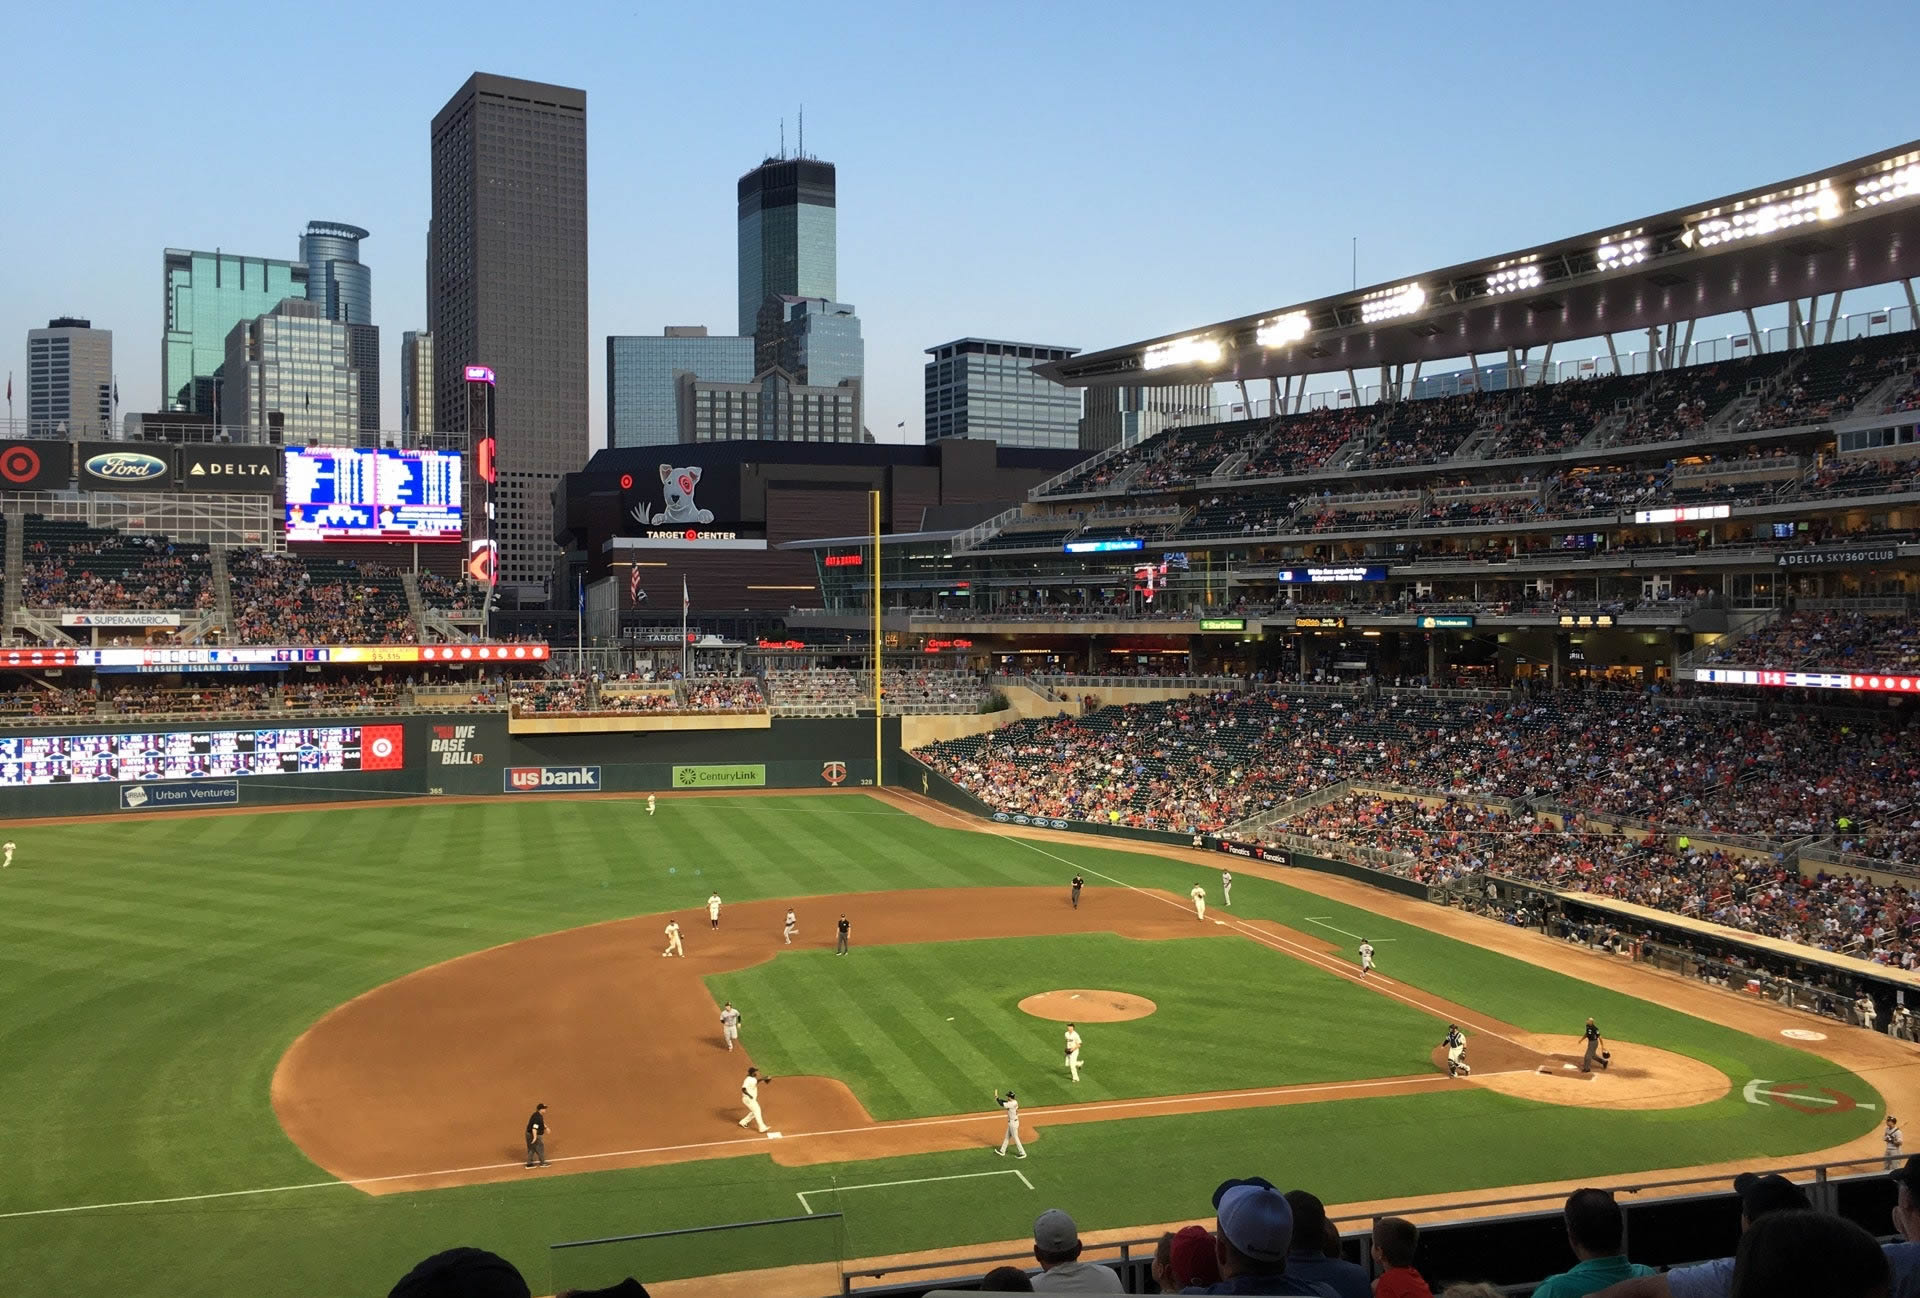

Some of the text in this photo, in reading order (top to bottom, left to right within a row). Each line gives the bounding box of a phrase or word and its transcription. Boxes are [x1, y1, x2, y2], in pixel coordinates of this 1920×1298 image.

[102, 456, 150, 476] Ford
[210, 463, 270, 475] DELTA
[647, 531, 736, 540] TARGET CENTER
[1789, 554, 1824, 564] DELTA
[1868, 551, 1894, 560] CLUB
[94, 616, 169, 624] SUPERAMERICA
[760, 640, 804, 650] Great Clips
[929, 639, 972, 648] Great Clips
[456, 726, 476, 738] WE
[431, 739, 466, 752] BASE
[442, 752, 473, 764] BALL
[700, 771, 756, 780] CenturyLink
[156, 789, 236, 800] Urban Ventures
[1229, 845, 1250, 856] Fanatics
[1263, 852, 1285, 863] Fanatics
